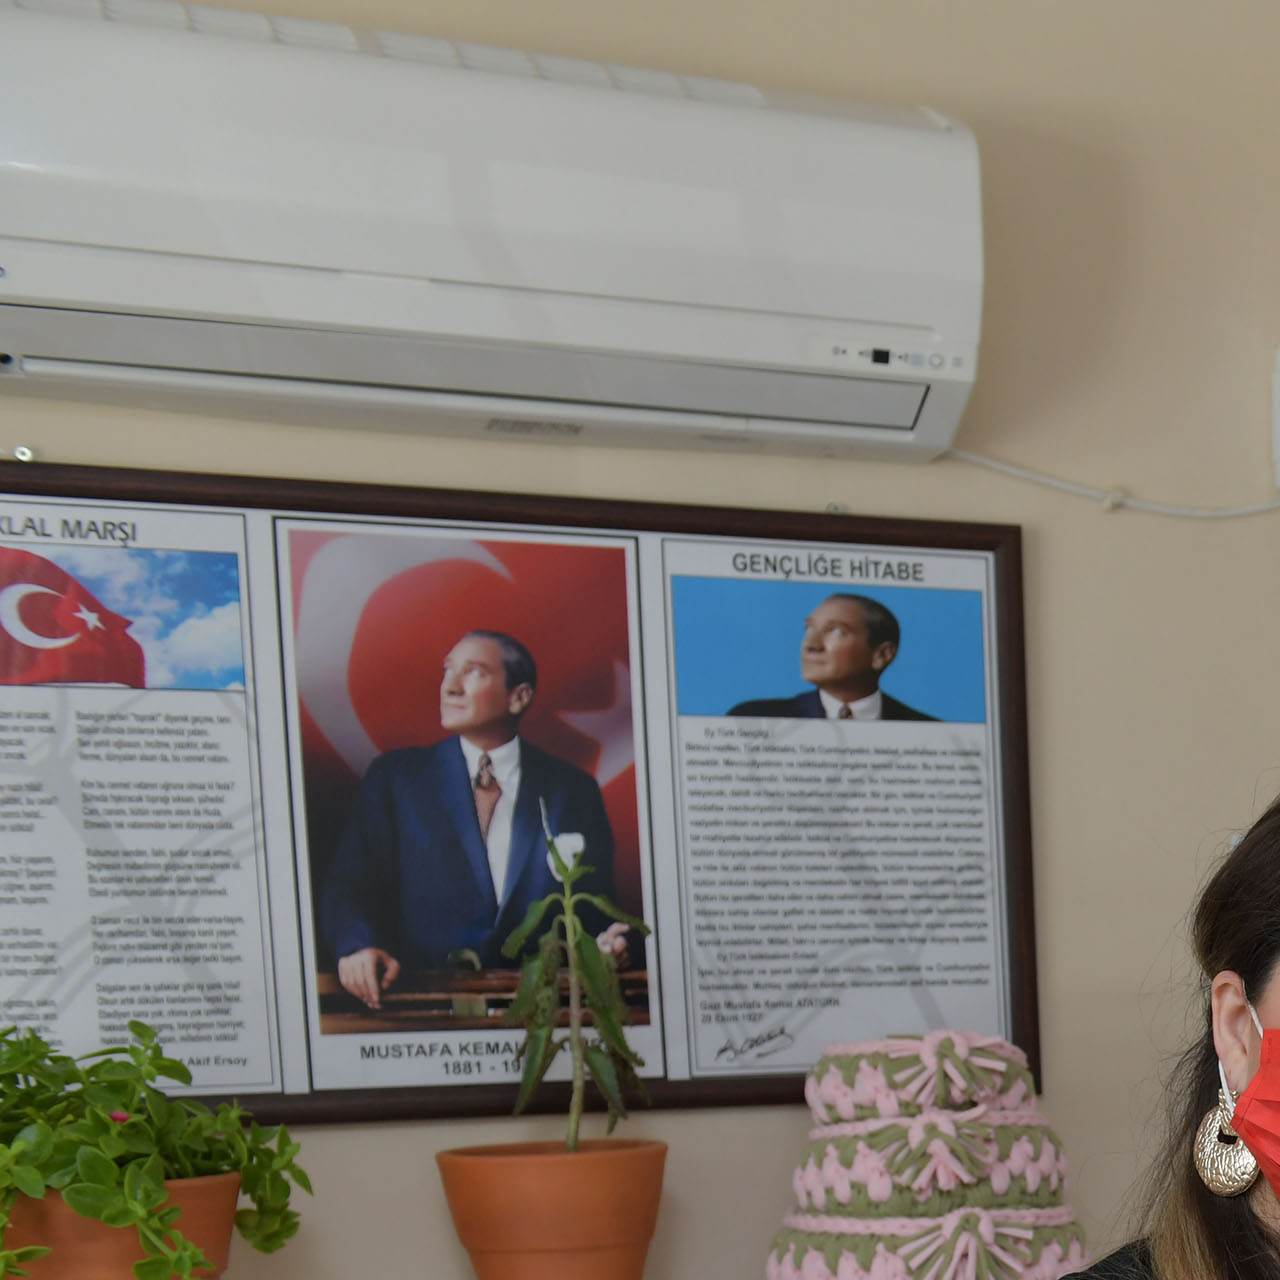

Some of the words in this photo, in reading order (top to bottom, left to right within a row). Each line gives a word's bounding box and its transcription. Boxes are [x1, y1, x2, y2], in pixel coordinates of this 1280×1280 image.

[61, 518, 136, 548] MARŞI
[732, 552, 843, 579] GENÇLİĞE
[851, 556, 924, 582] HİTABE
[360, 1042, 451, 1060] MUSTAFA
[187, 1055, 211, 1065] Akif
[214, 1055, 248, 1068] Ersoy
[443, 1061, 482, 1075] 1881
